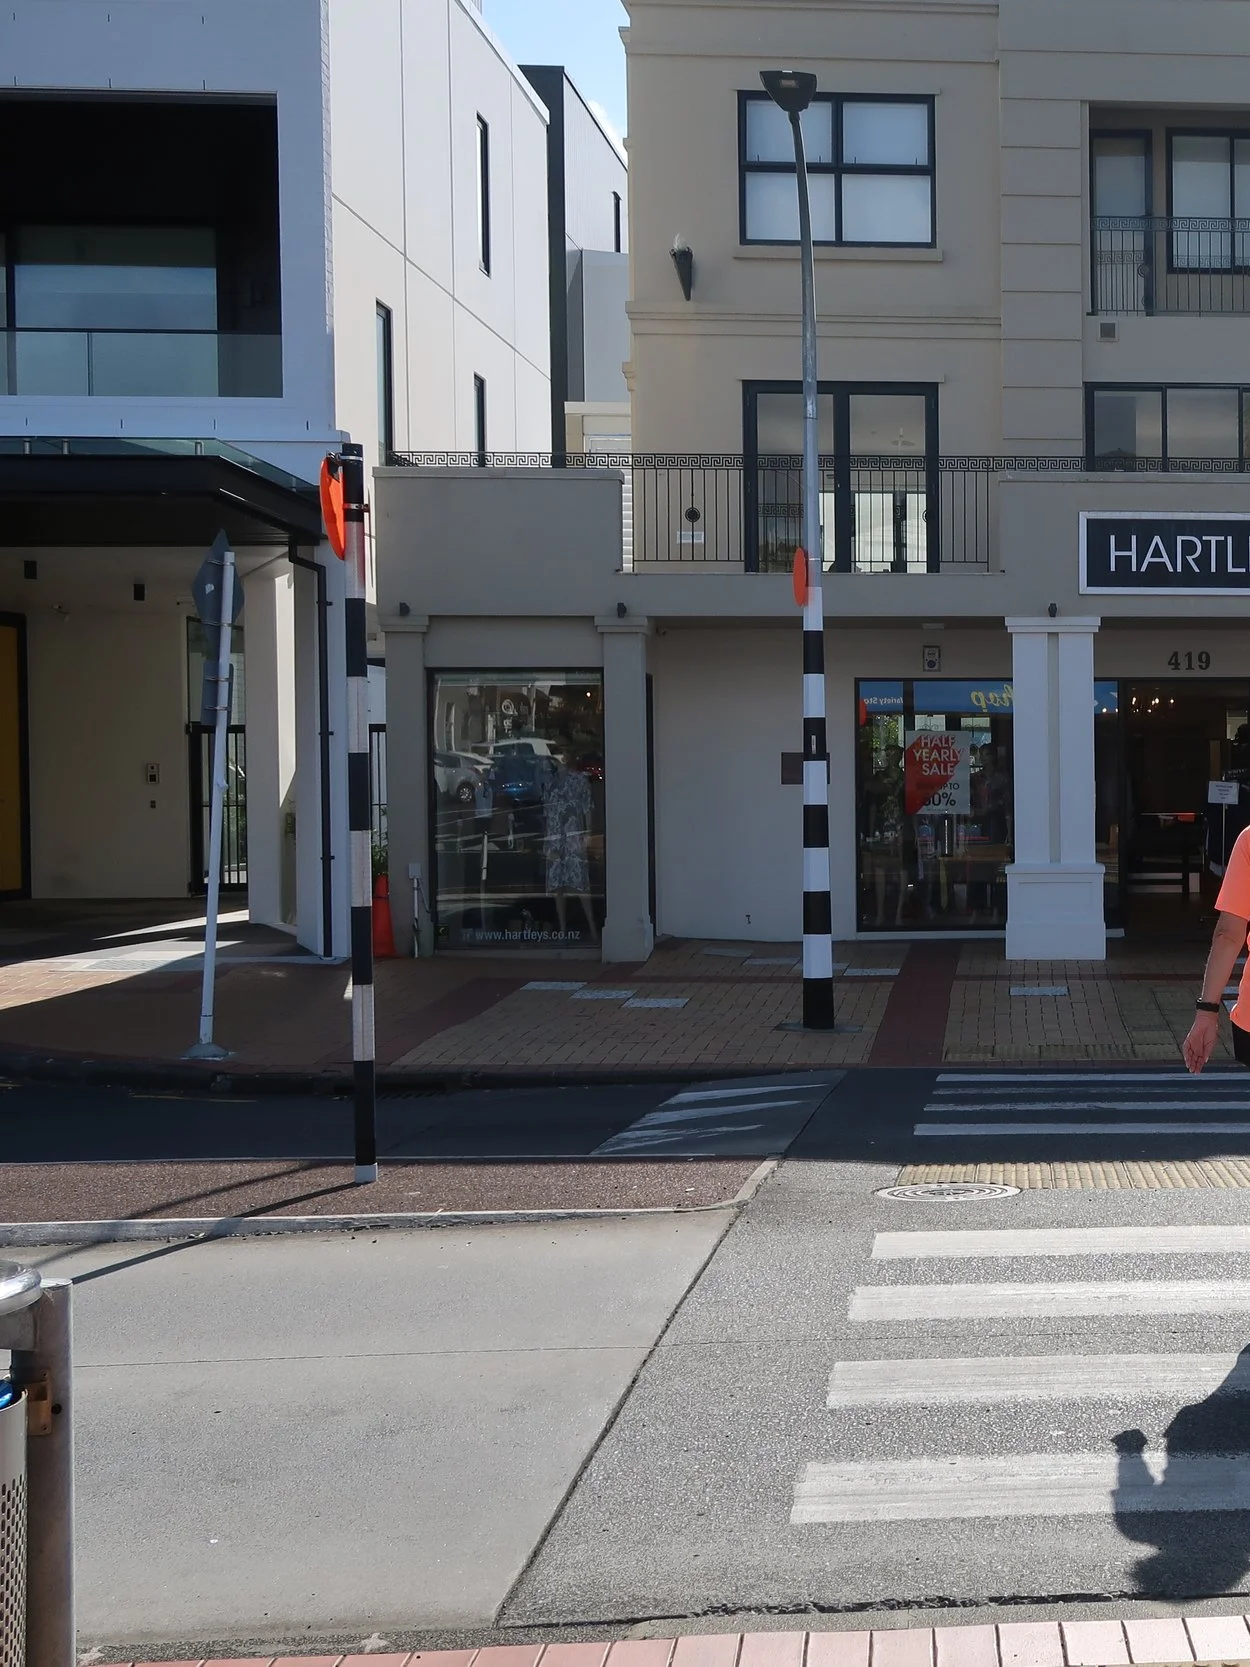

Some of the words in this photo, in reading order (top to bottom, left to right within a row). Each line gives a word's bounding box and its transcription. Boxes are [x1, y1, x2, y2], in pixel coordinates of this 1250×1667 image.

[1167, 651, 1211, 671] 419
[921, 735, 956, 747] HALF
[913, 749, 962, 761] YEARLY
[921, 763, 956, 776] SALE
[475, 928, 581, 942] www.hartleys.co.nz
